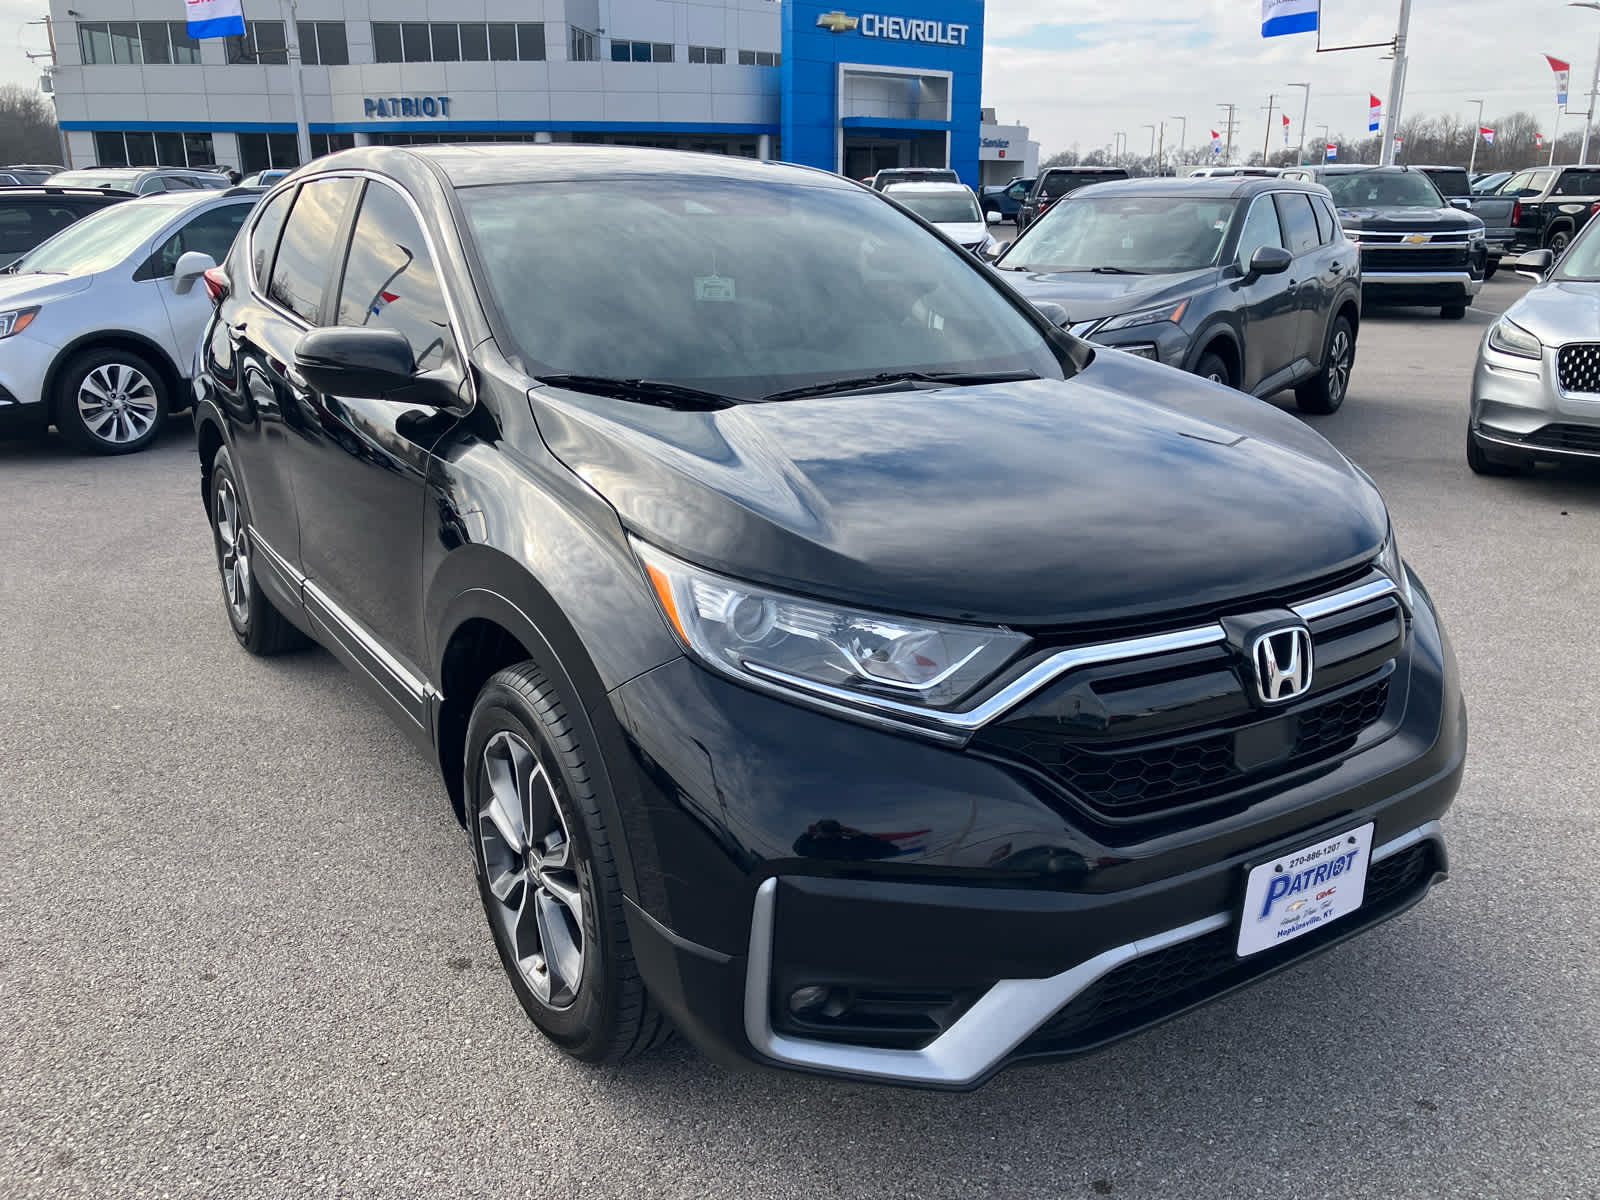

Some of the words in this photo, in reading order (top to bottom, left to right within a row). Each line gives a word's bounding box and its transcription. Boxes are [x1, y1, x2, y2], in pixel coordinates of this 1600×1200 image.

[862, 14, 969, 46] CHEVROLET
[363, 96, 450, 117] PATRIOT
[1289, 842, 1341, 868] 270-886-1207
[1260, 848, 1359, 918] PATRIOT
[1315, 886, 1336, 901] GMC
[1323, 908, 1334, 919] KY
